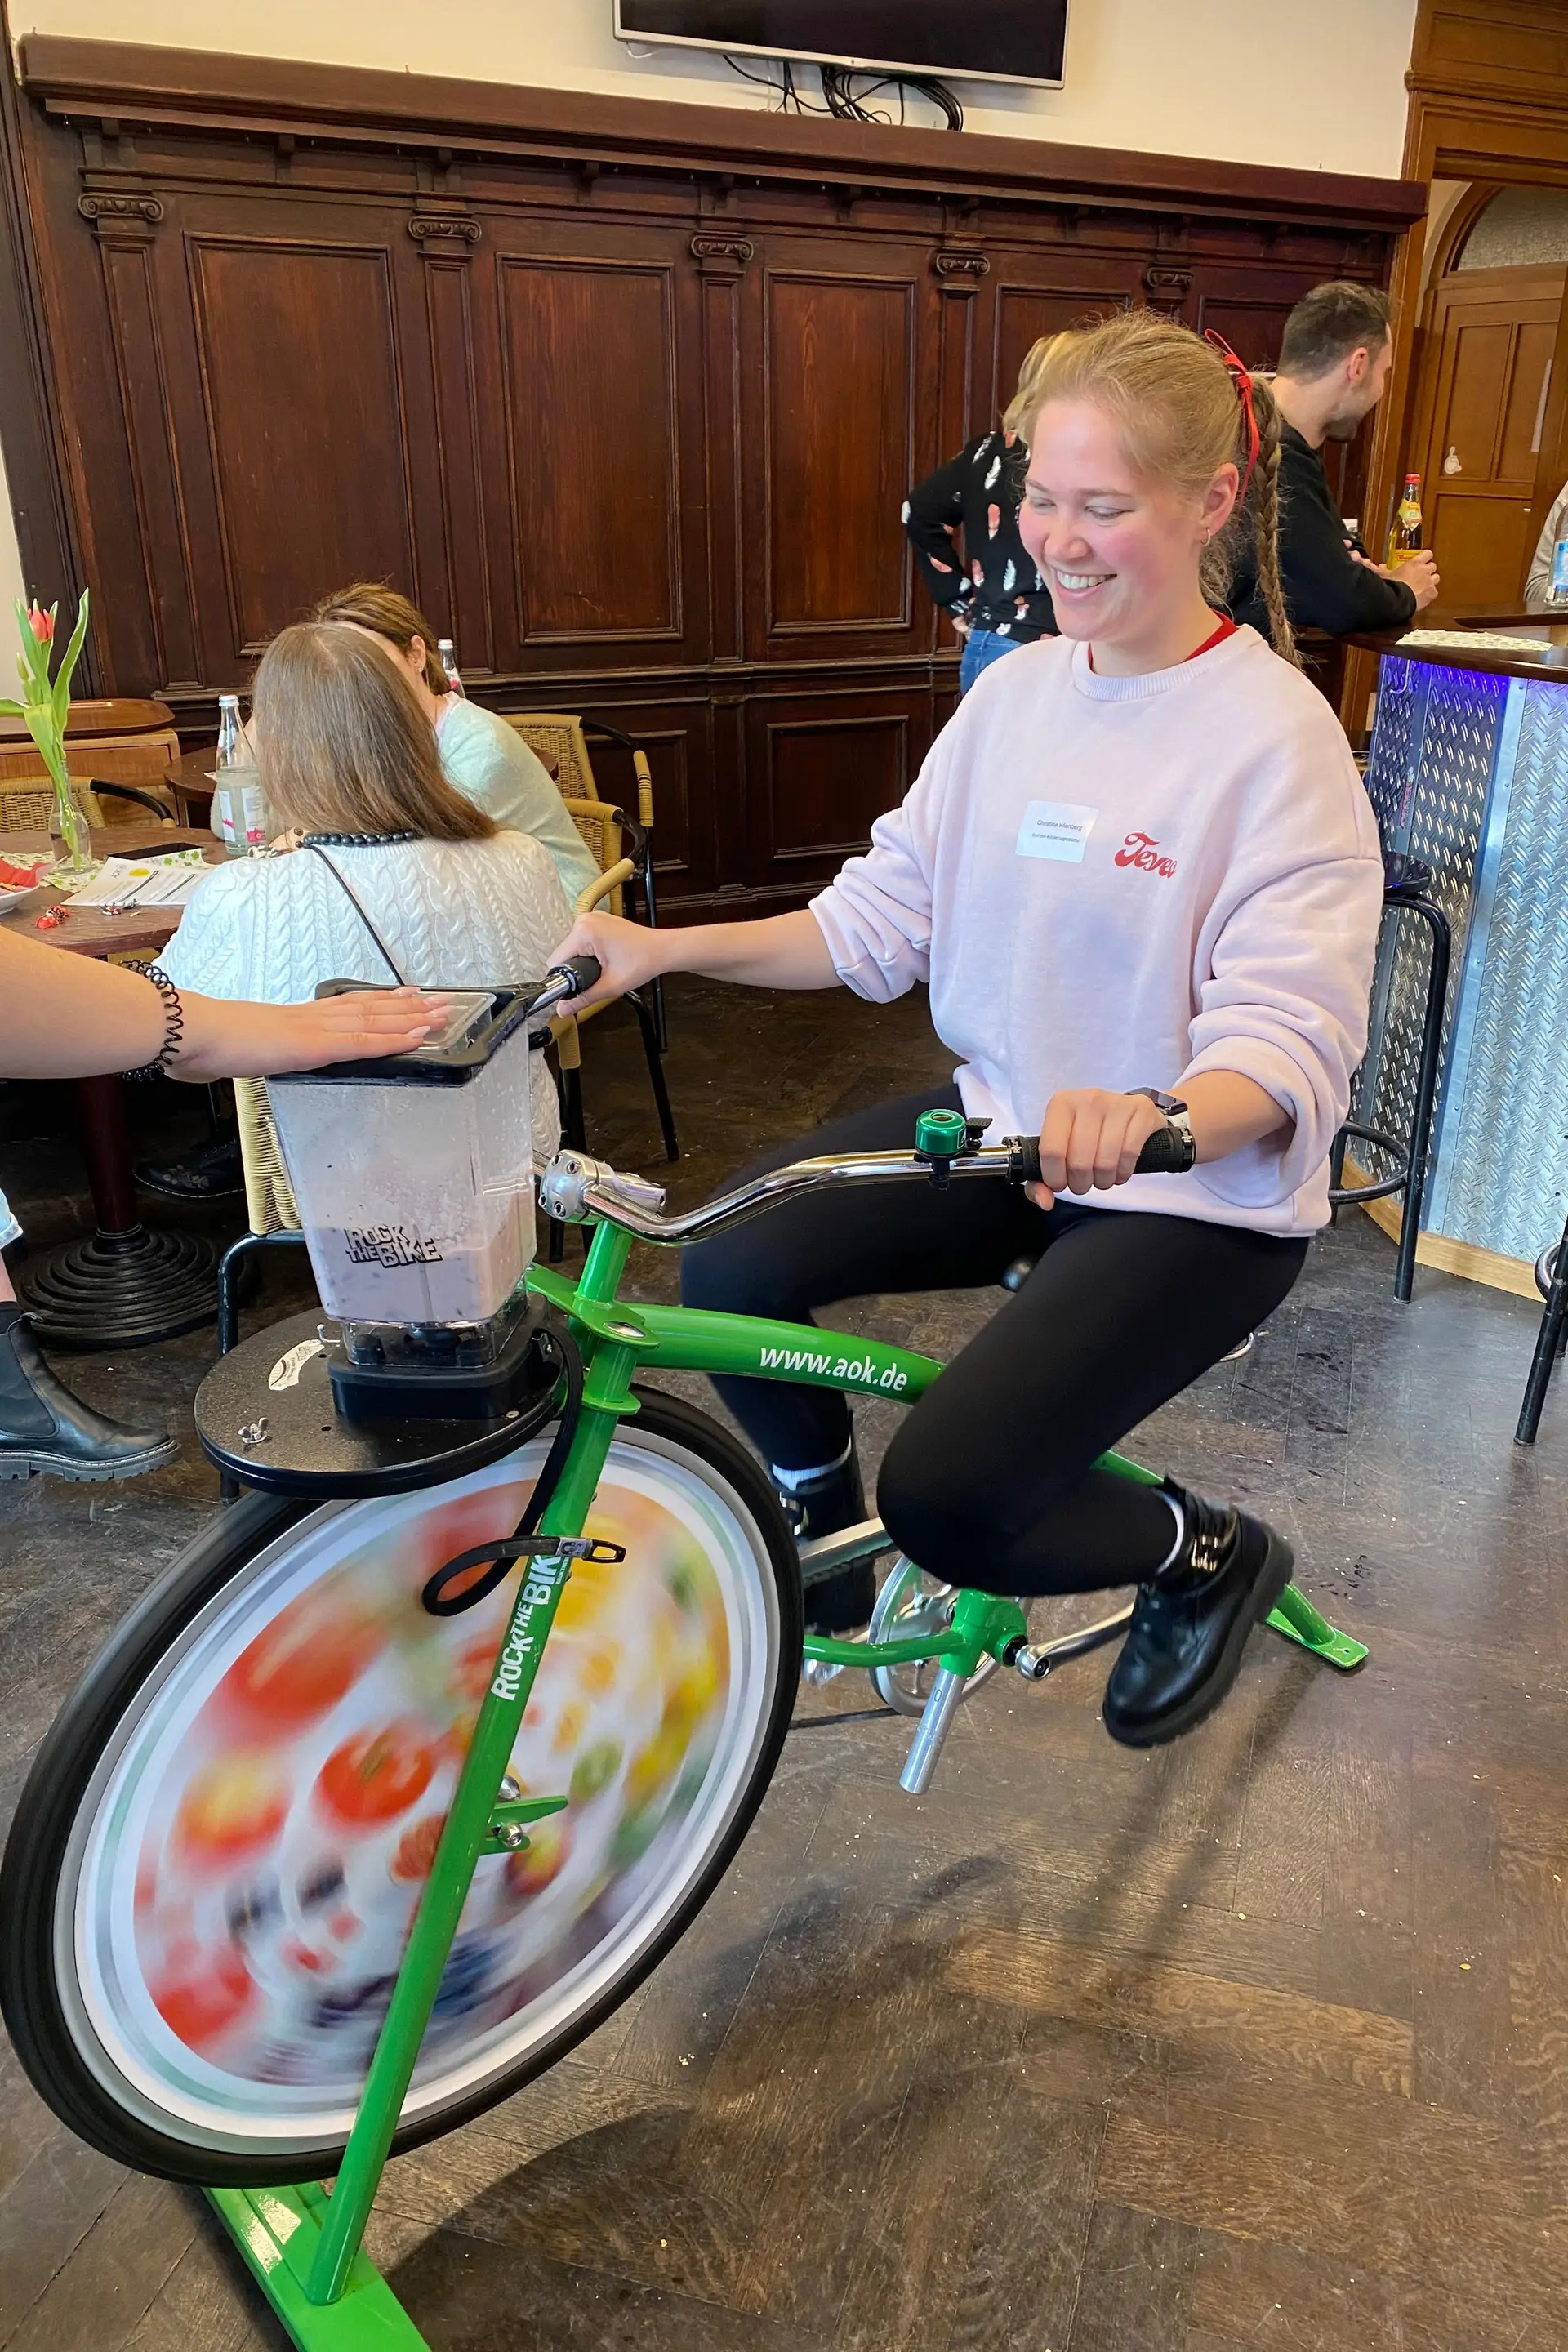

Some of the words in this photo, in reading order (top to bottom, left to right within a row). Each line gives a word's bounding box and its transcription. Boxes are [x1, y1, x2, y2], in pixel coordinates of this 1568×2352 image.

[344, 1224, 409, 1248] ROCK
[345, 1246, 380, 1263] THE
[376, 1237, 443, 1268] BIKE
[760, 1347, 908, 1391] www.aok.de
[522, 1554, 562, 1606] BIK
[510, 1601, 535, 1635] THE
[490, 1634, 535, 1701] ROCK
